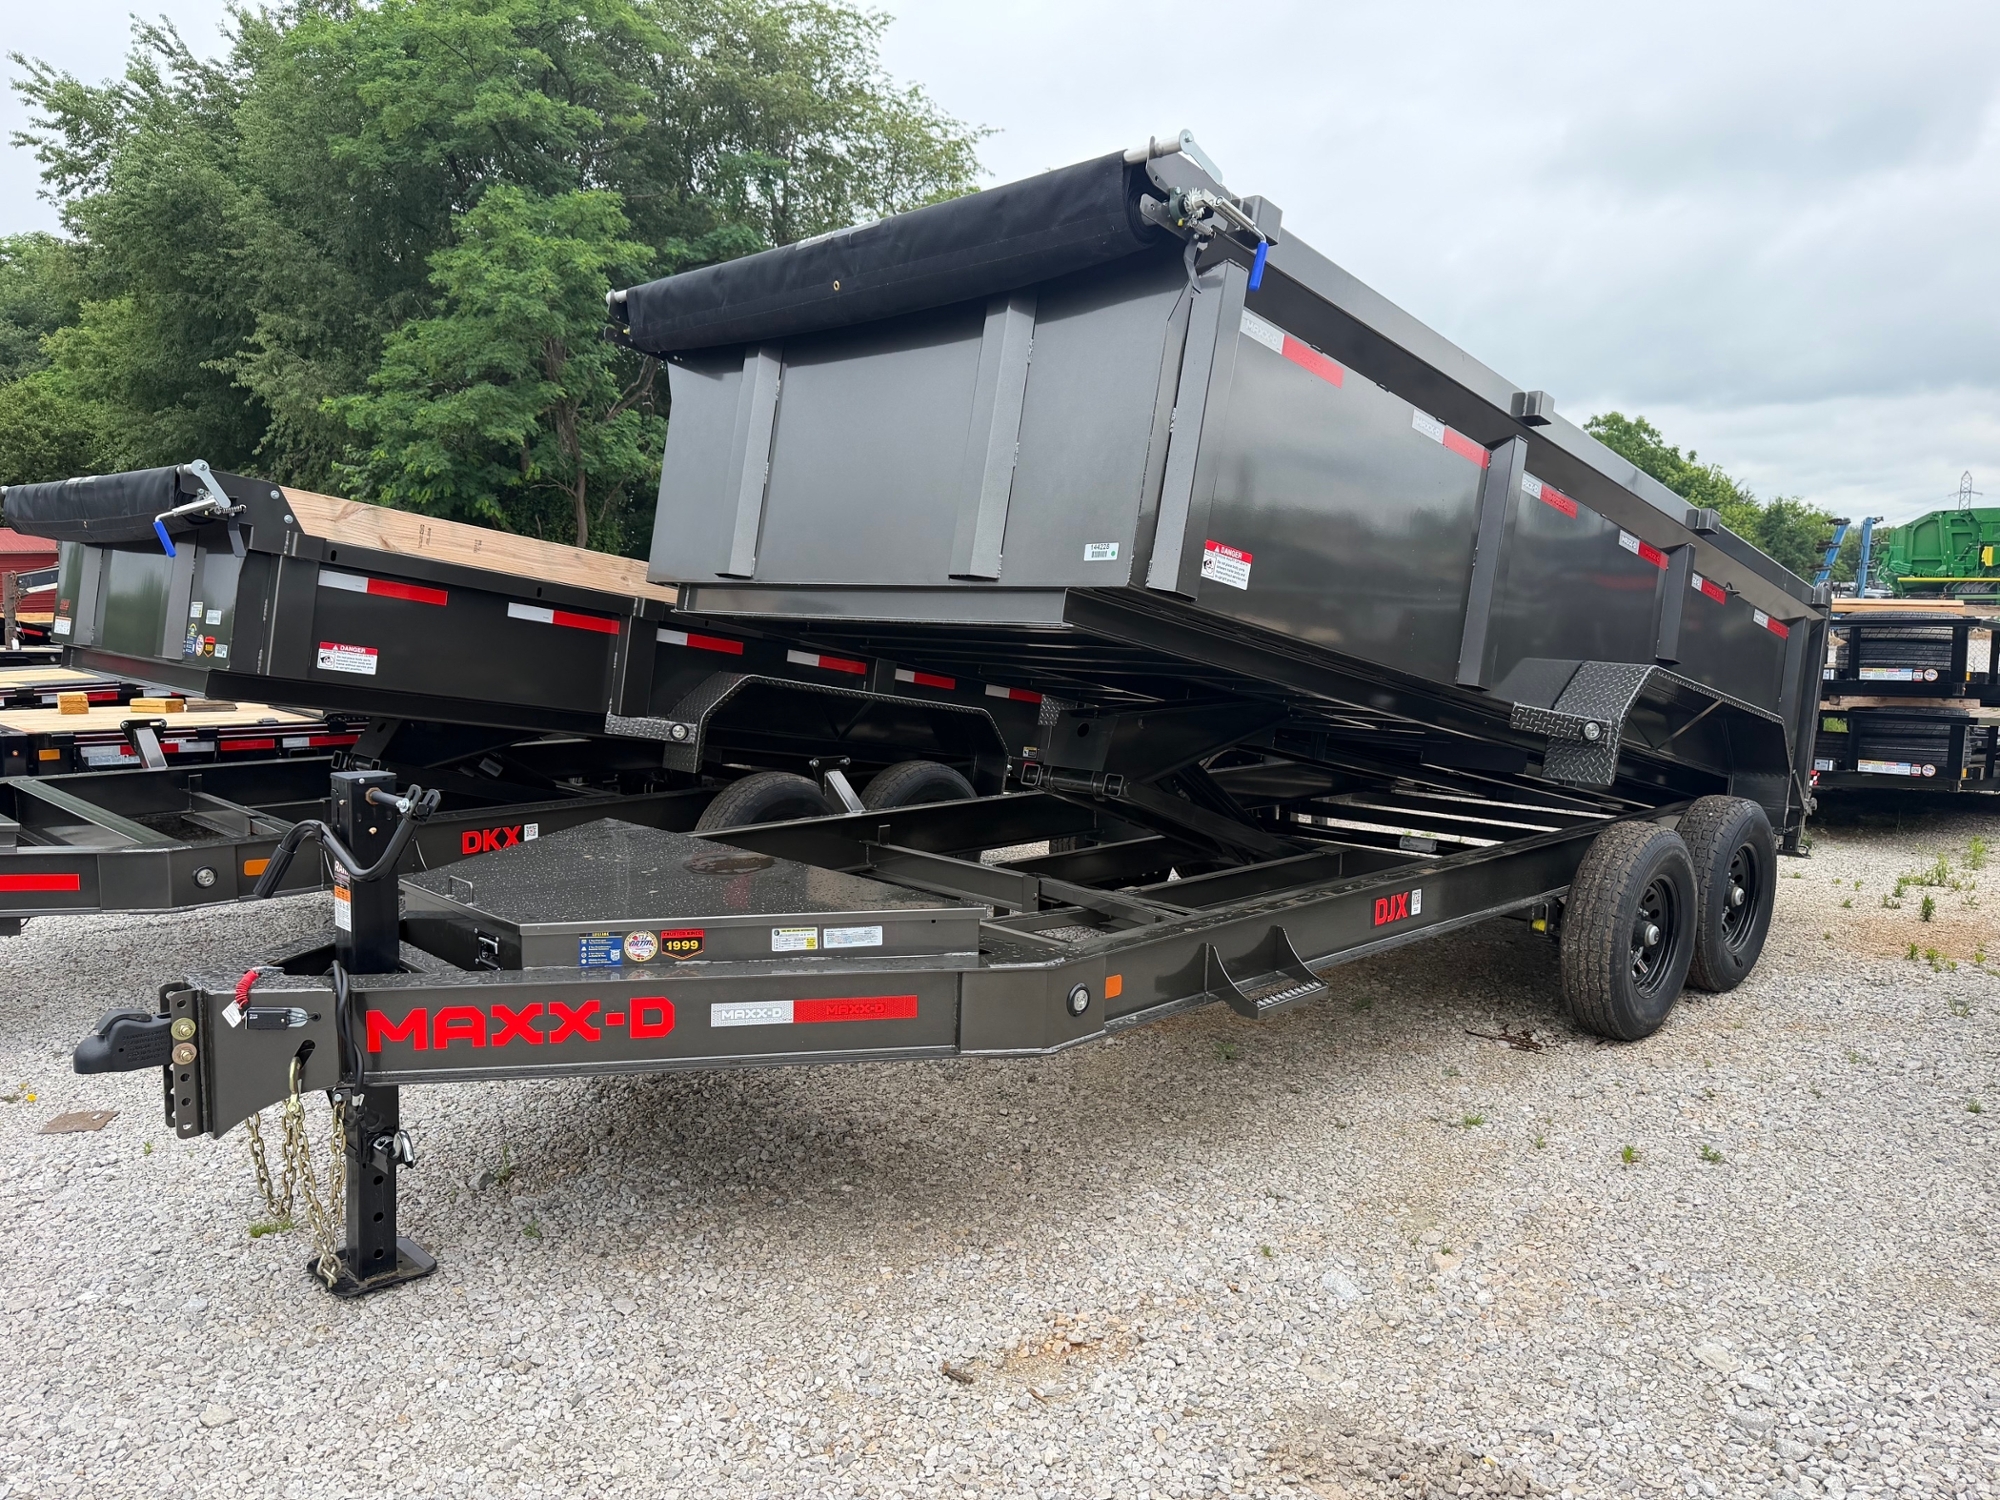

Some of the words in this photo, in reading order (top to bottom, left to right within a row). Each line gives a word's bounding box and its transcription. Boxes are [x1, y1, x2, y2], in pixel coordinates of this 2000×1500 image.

[1220, 546, 1243, 560] DANGER
[340, 645, 366, 654] DANGER
[462, 825, 521, 855] DKX
[1375, 892, 1409, 925] DJX
[666, 940, 699, 951] 1999
[721, 1007, 782, 1020] MAXX-D
[825, 1003, 885, 1016] MAXX-D
[366, 996, 675, 1053] MAXX-D
